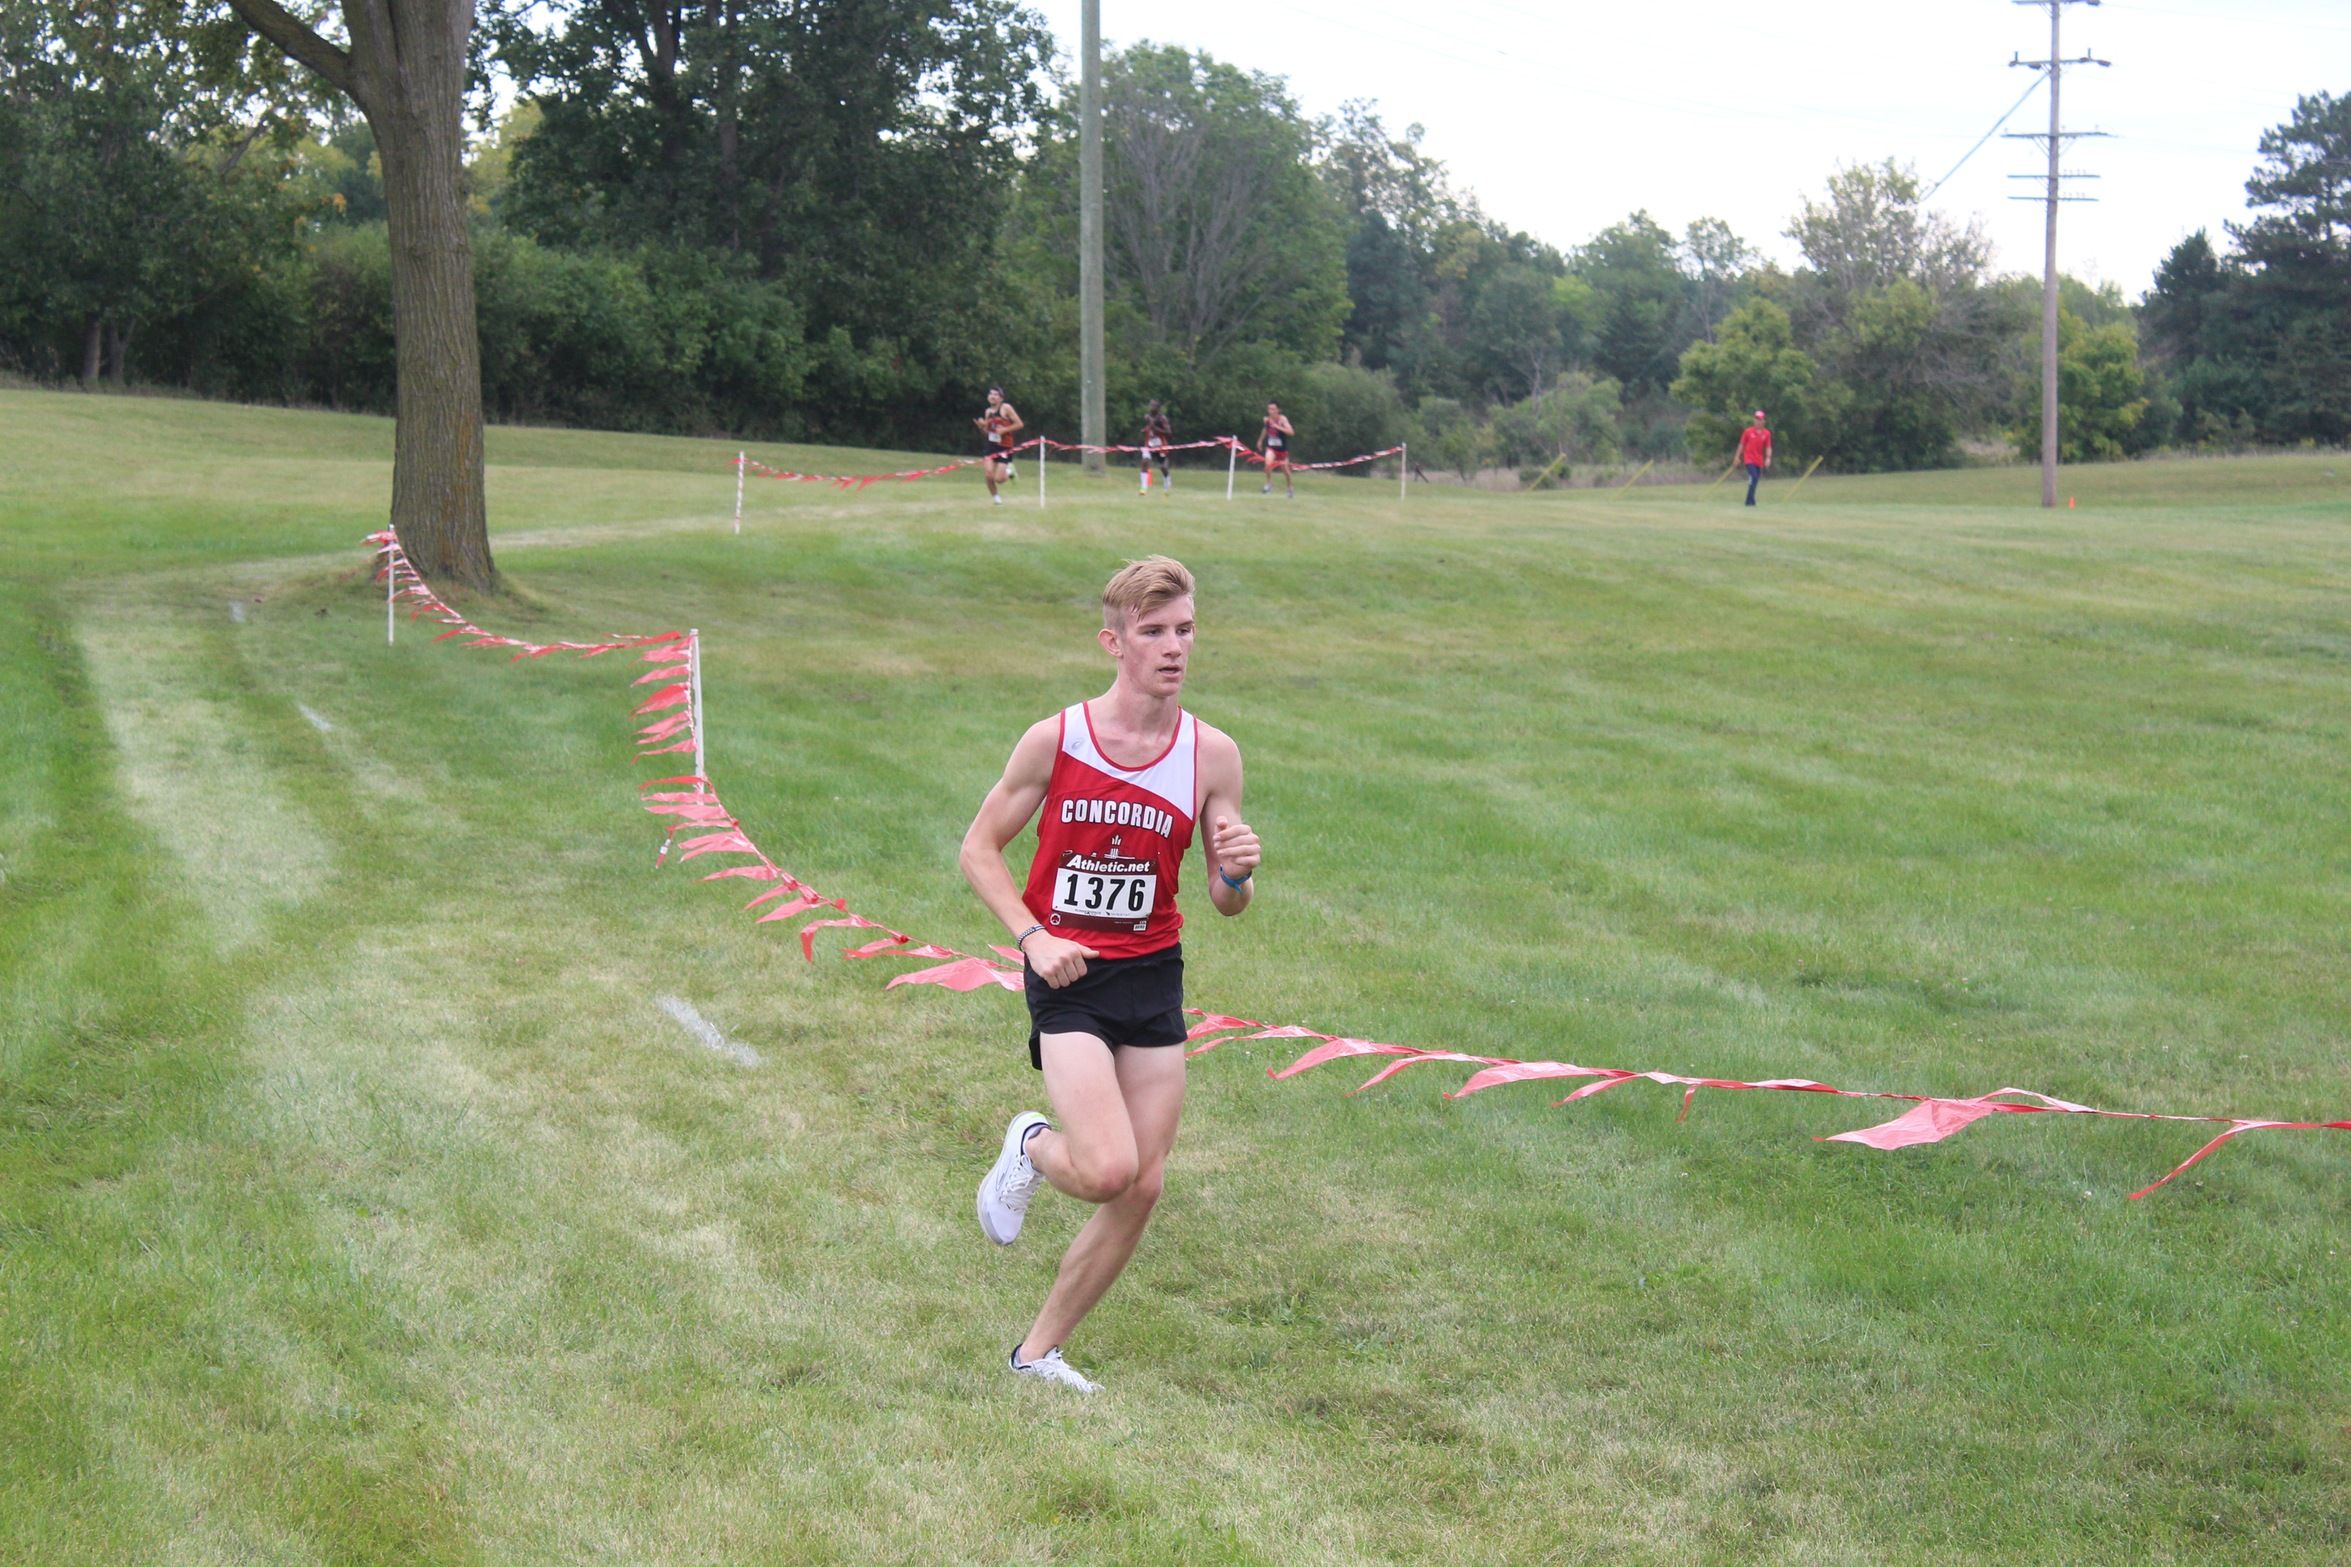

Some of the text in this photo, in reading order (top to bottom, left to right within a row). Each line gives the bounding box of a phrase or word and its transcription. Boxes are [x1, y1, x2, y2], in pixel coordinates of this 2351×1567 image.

[1061, 799, 1173, 838] CONCORDIA
[1066, 854, 1150, 872] Athletic.net
[1063, 873, 1146, 911] 1376
